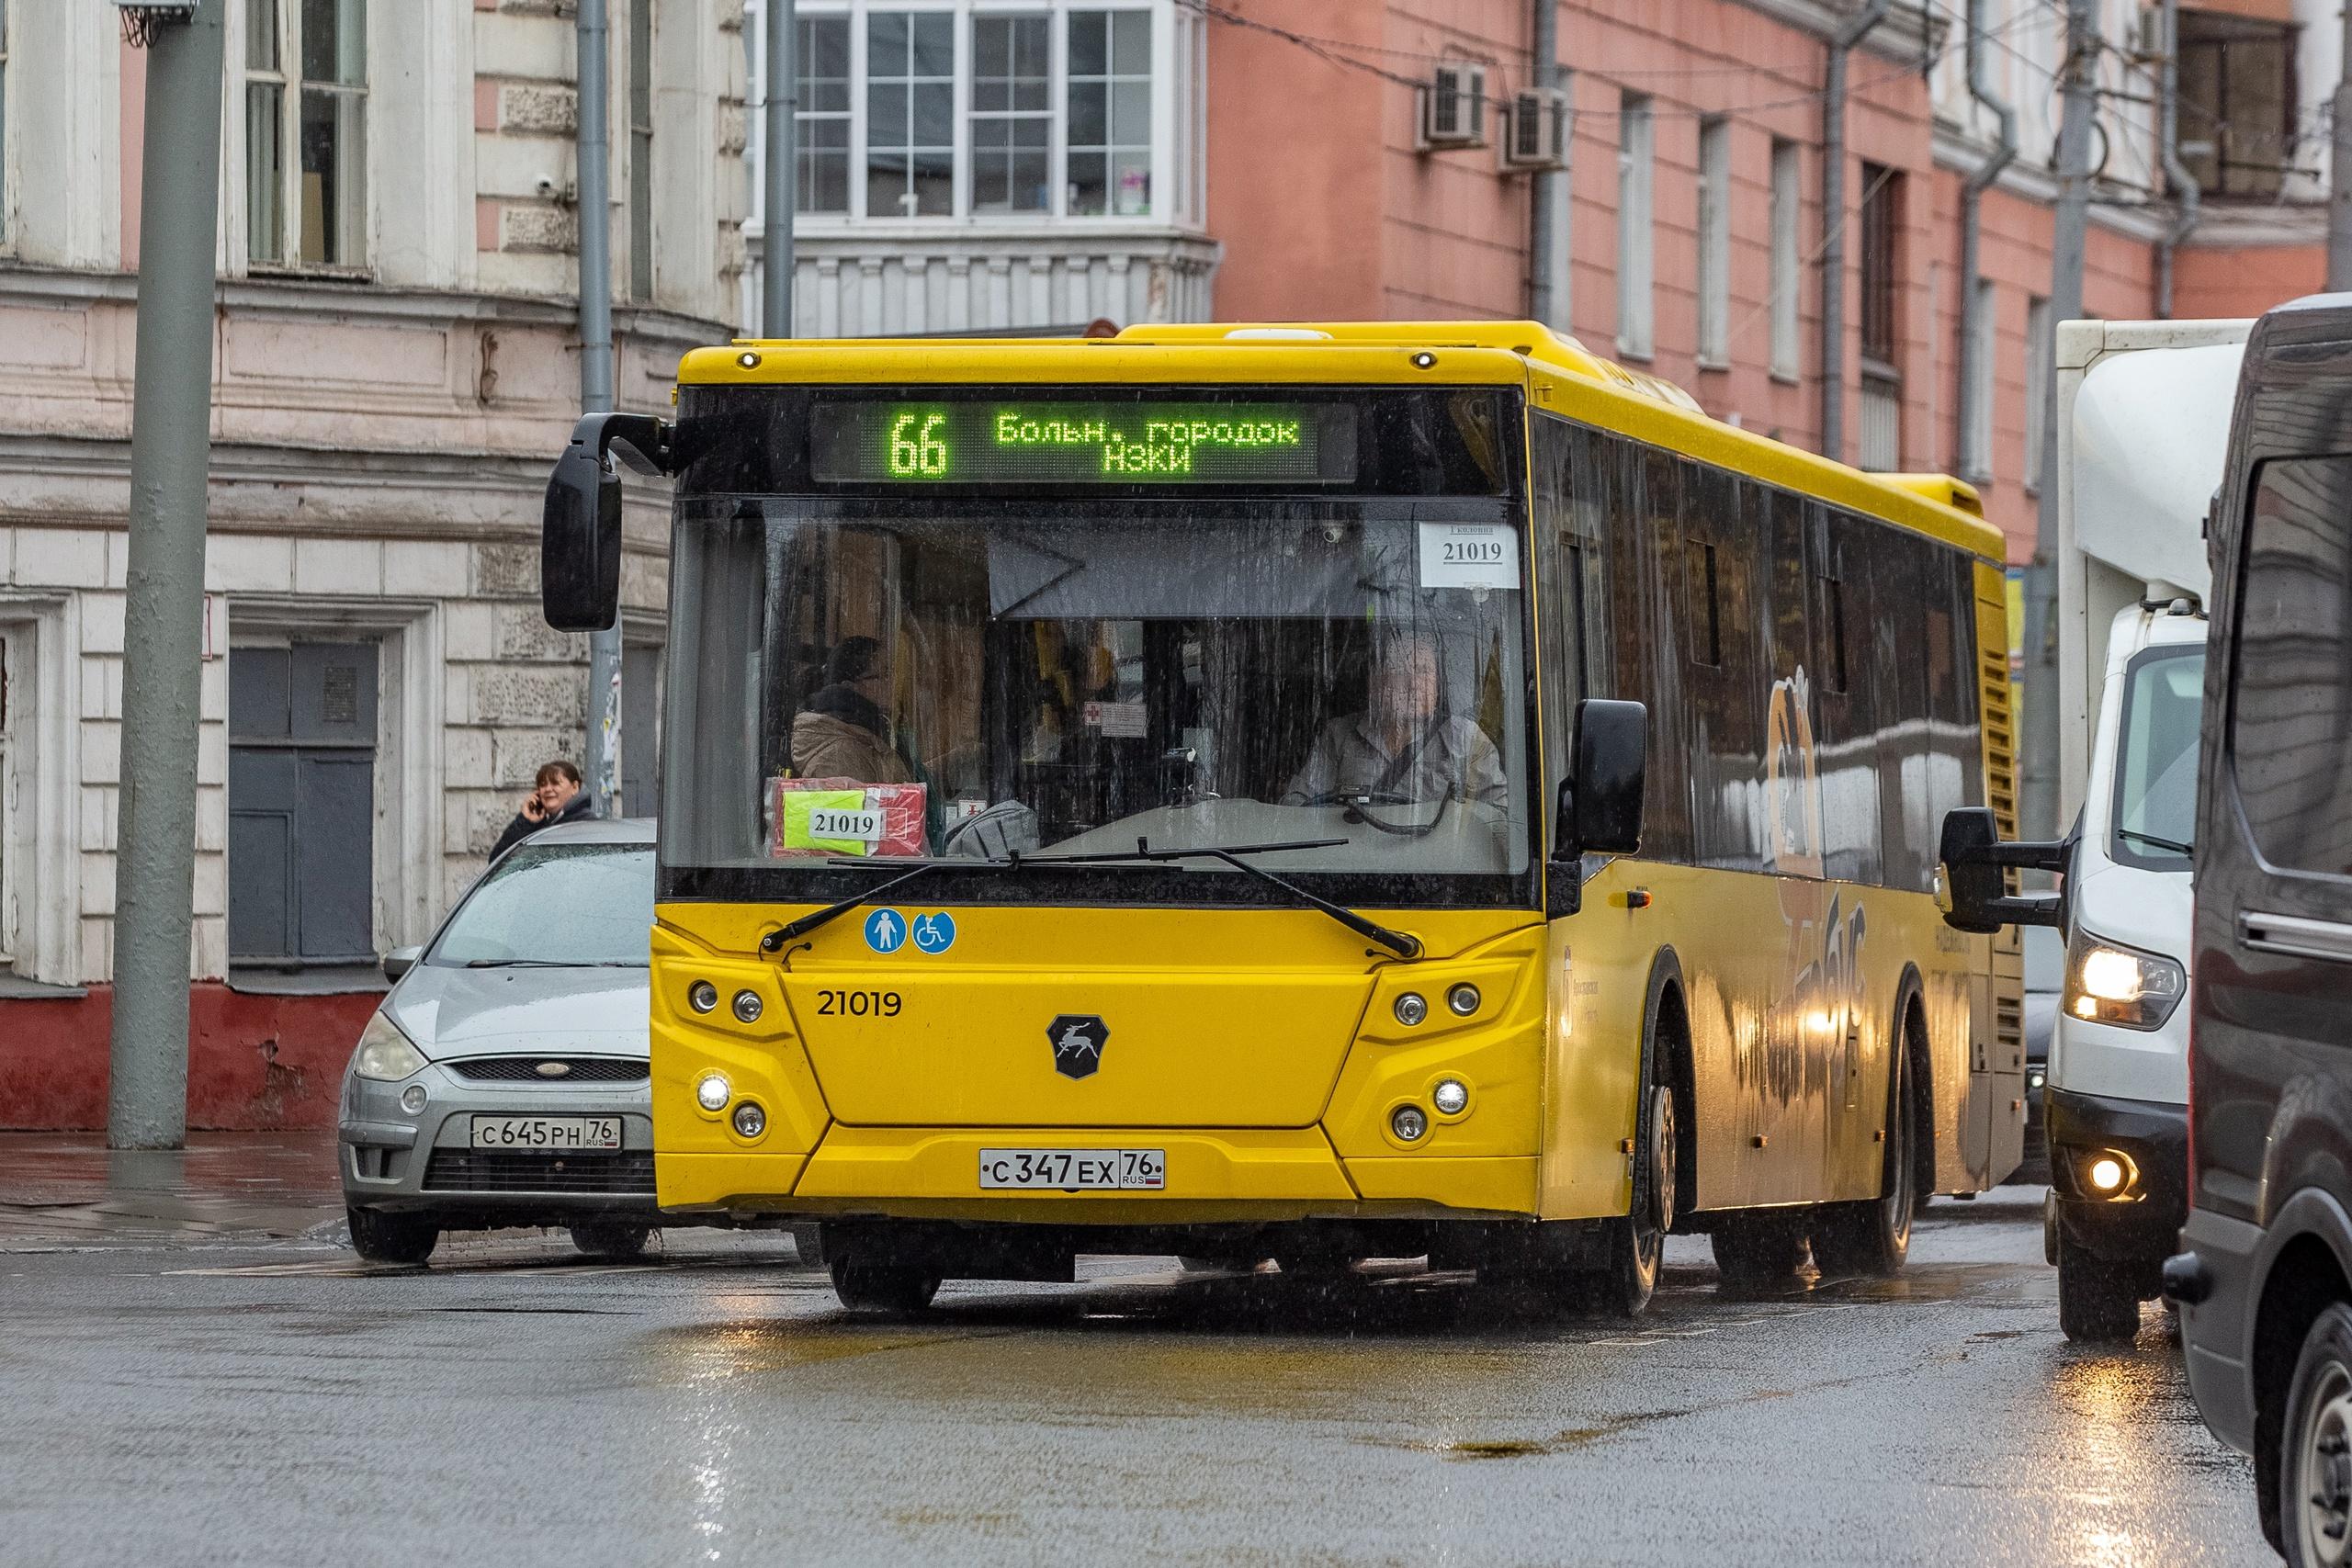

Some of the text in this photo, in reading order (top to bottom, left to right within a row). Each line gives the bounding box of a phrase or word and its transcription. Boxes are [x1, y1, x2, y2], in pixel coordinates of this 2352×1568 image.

[998, 413, 1300, 446] Больн. городок
[890, 414, 947, 474] 66
[1105, 444, 1191, 471] НЗКИ
[1442, 542, 1502, 560] 21019
[814, 814, 874, 834] 21019
[817, 990, 902, 1017] 21019
[589, 1121, 613, 1139] 76
[1124, 1153, 1153, 1176] 76
[1122, 1176, 1144, 1185] RUS
